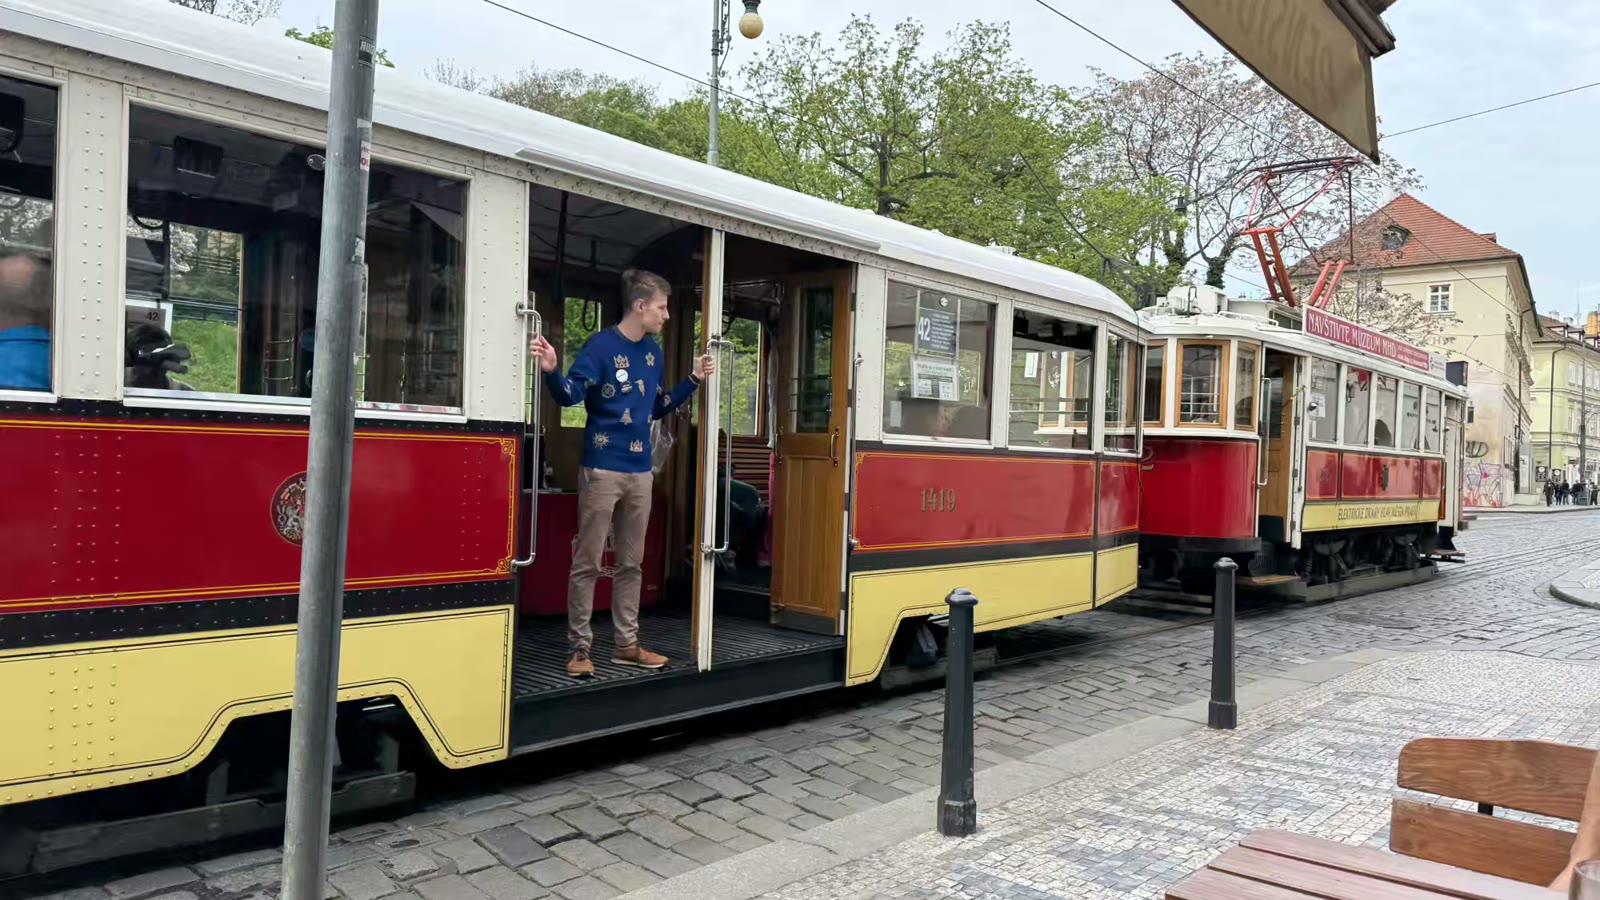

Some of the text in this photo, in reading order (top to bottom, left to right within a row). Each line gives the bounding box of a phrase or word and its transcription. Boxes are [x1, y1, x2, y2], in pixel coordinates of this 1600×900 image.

[145, 311, 160, 321] 42
[918, 316, 931, 341] 42
[1351, 328, 1381, 353] MUZEUM
[1382, 338, 1397, 358] MHD
[921, 487, 957, 512] 1419
